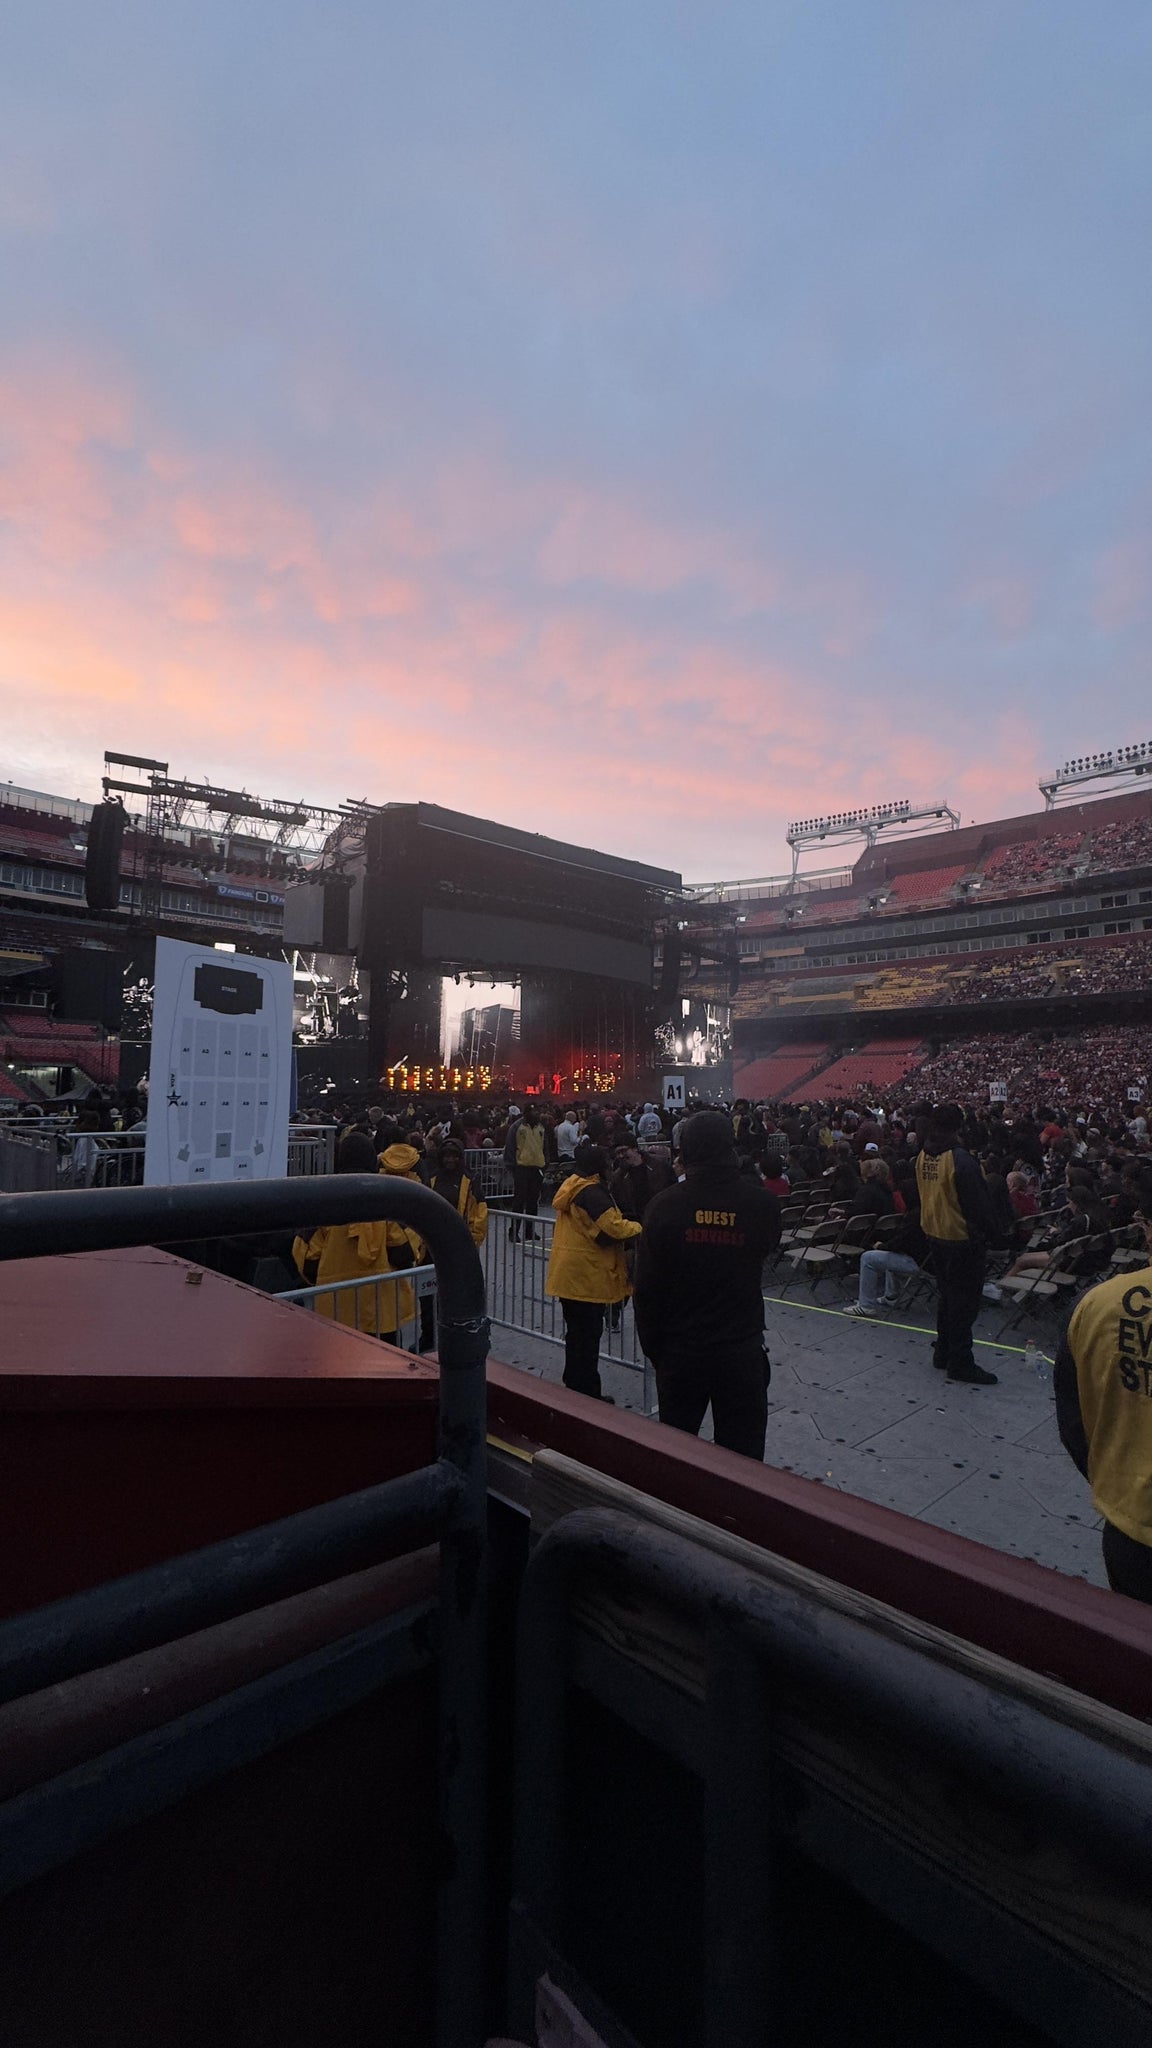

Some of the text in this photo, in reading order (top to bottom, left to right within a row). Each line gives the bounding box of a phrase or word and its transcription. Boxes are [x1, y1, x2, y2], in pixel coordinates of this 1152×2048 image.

[667, 1084, 682, 1100] A1
[991, 1087, 999, 1097] A2
[1129, 1090, 1139, 1099] A3
[695, 1210, 737, 1227] GUEST
[685, 1229, 745, 1247] SERVICES
